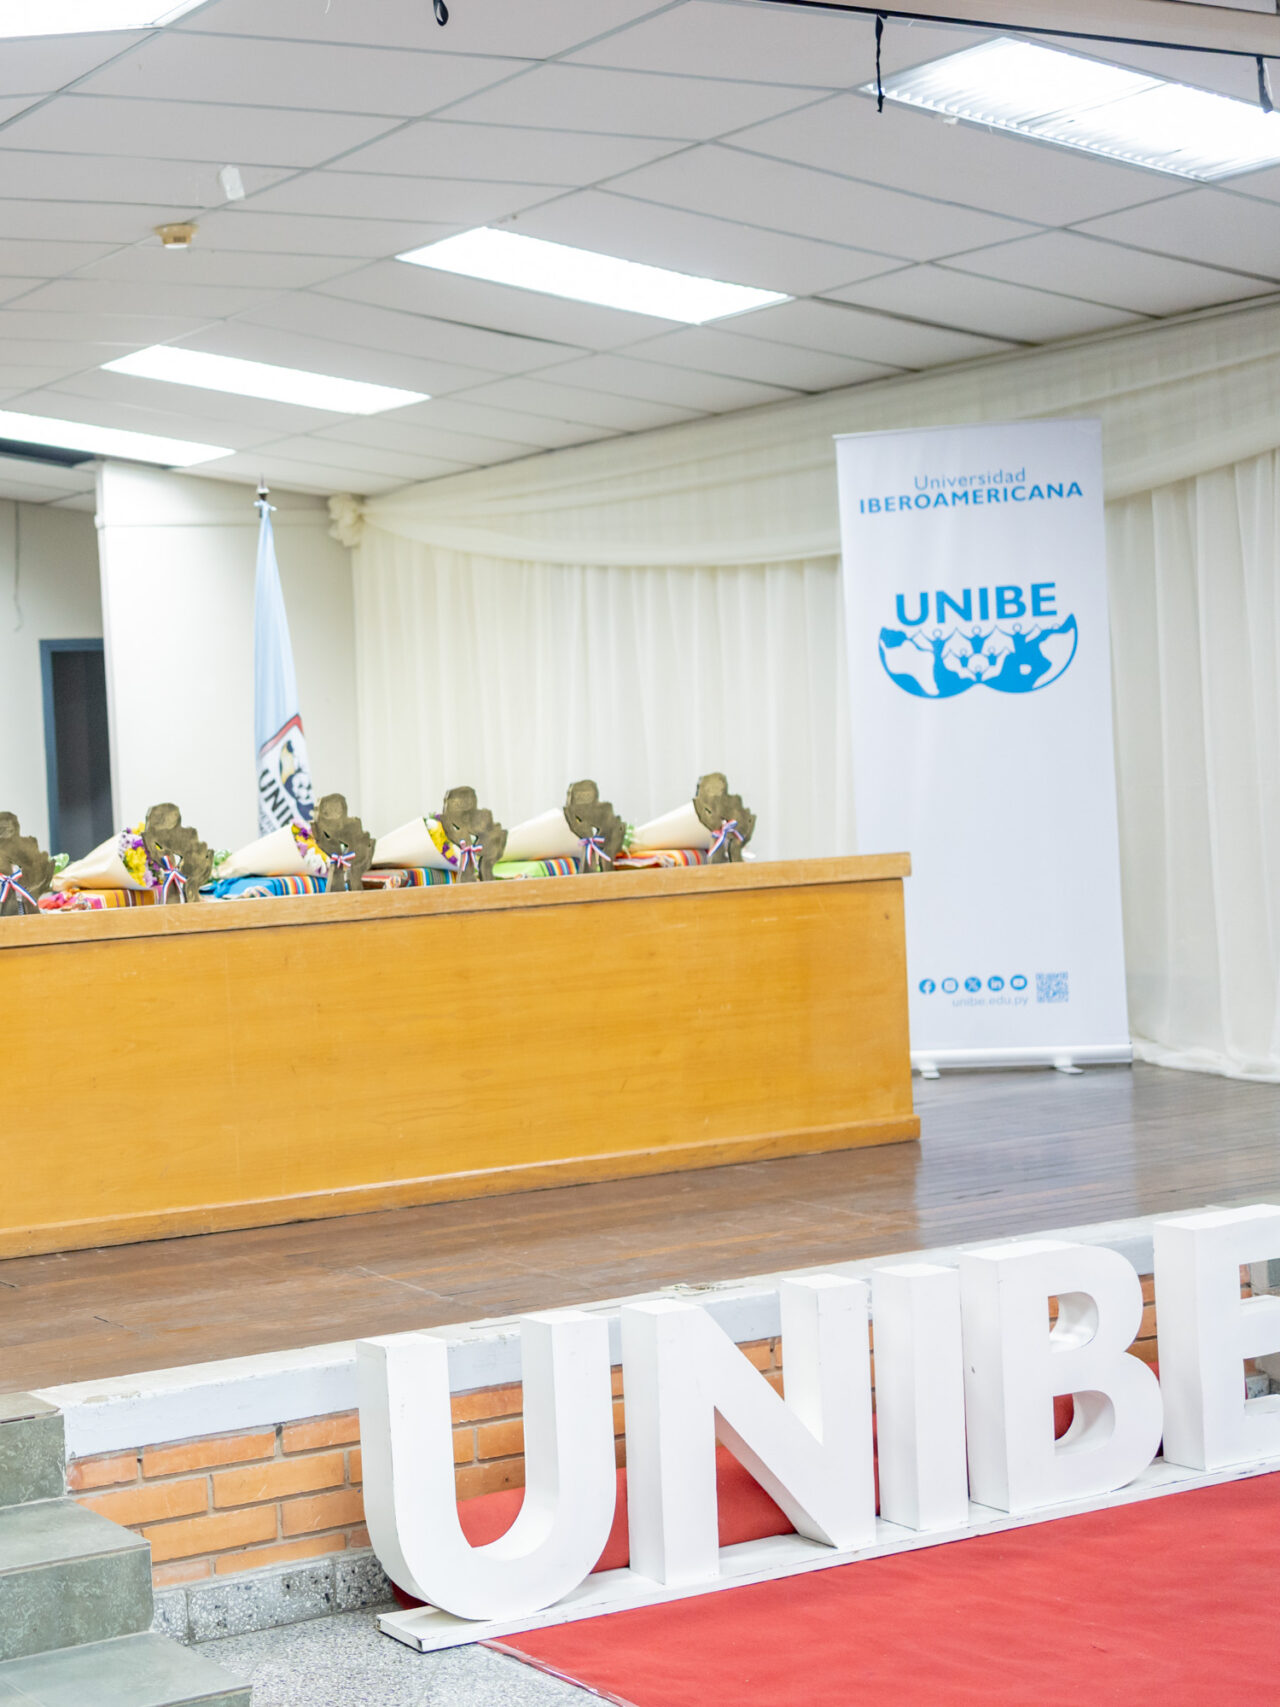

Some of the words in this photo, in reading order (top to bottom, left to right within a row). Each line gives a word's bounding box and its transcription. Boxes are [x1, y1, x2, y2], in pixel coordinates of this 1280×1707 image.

[860, 481, 1083, 514] IBEROAMERICANA
[914, 467, 1026, 491] Universidad
[896, 582, 1057, 627] UNIBE
[356, 1204, 1280, 1621] UNIBE
